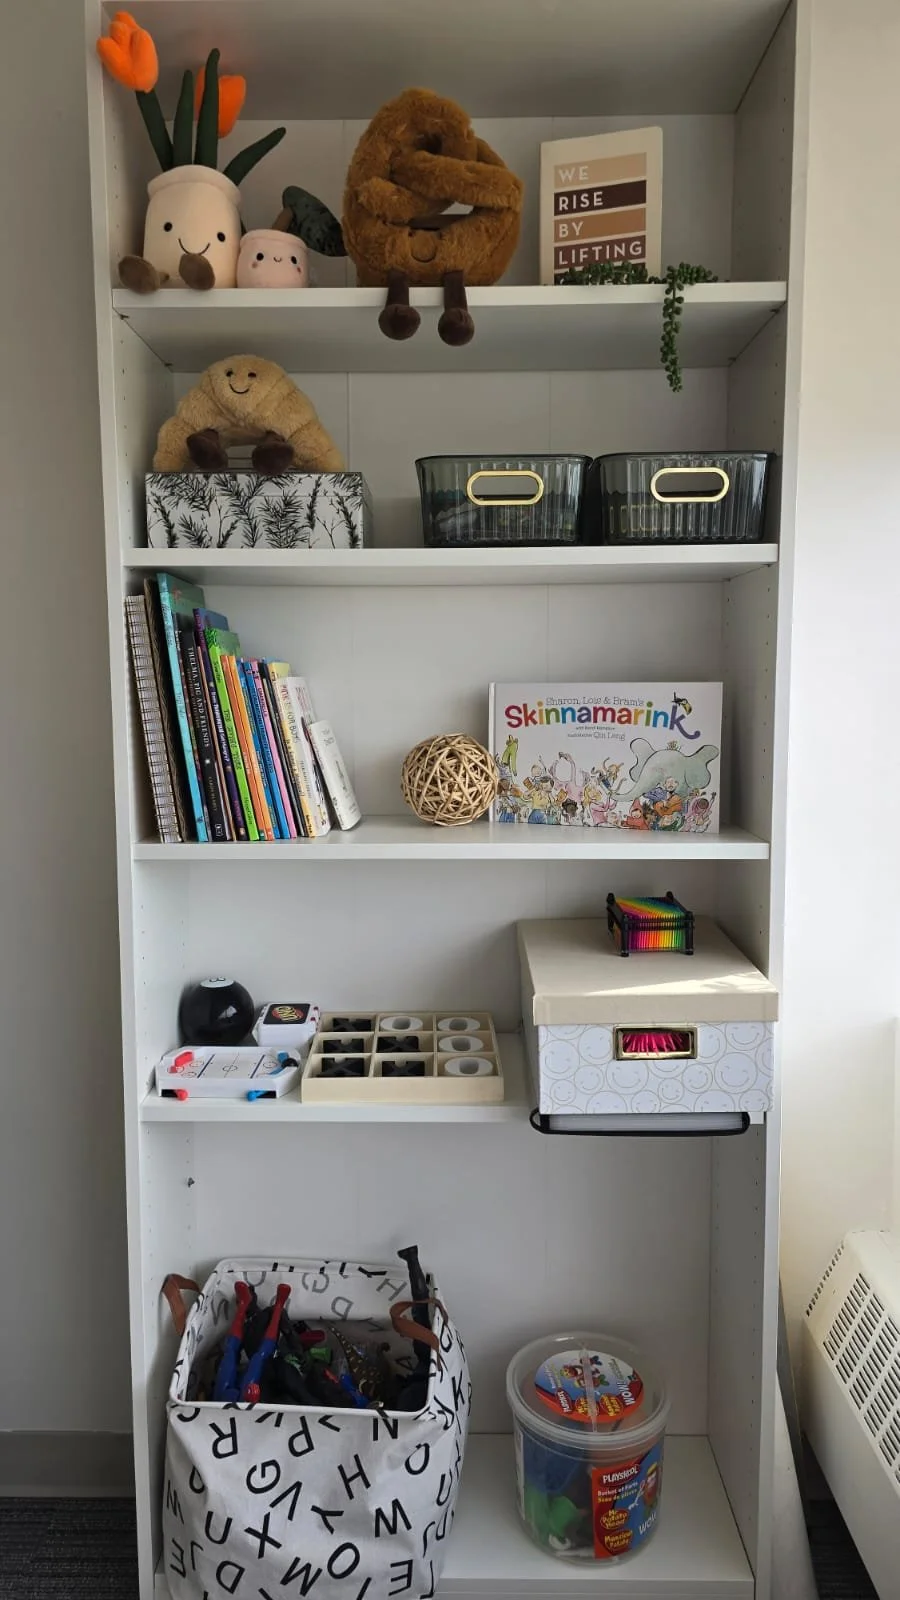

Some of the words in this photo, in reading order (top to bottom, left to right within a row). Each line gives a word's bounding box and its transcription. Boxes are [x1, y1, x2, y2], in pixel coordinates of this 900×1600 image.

[558, 166, 589, 183] WE
[558, 191, 603, 211] RISE
[558, 221, 584, 238] BY
[558, 241, 643, 265] LIFTING
[186, 647, 198, 680] THELMA,
[198, 715, 210, 747] FRIENDS
[504, 701, 701, 740] Skinnamarink
[209, 1417, 238, 1459] R
[288, 1415, 315, 1457] P
[246, 1459, 281, 1494] G
[337, 1454, 371, 1500] H
[603, 1465, 639, 1484] PLAYSKOOL
[205, 1511, 233, 1544] U
[244, 1511, 282, 1559] X
[311, 1505, 344, 1535] Y
[216, 1560, 245, 1594] D
[327, 1542, 360, 1579] O
[388, 1559, 413, 1596] E
